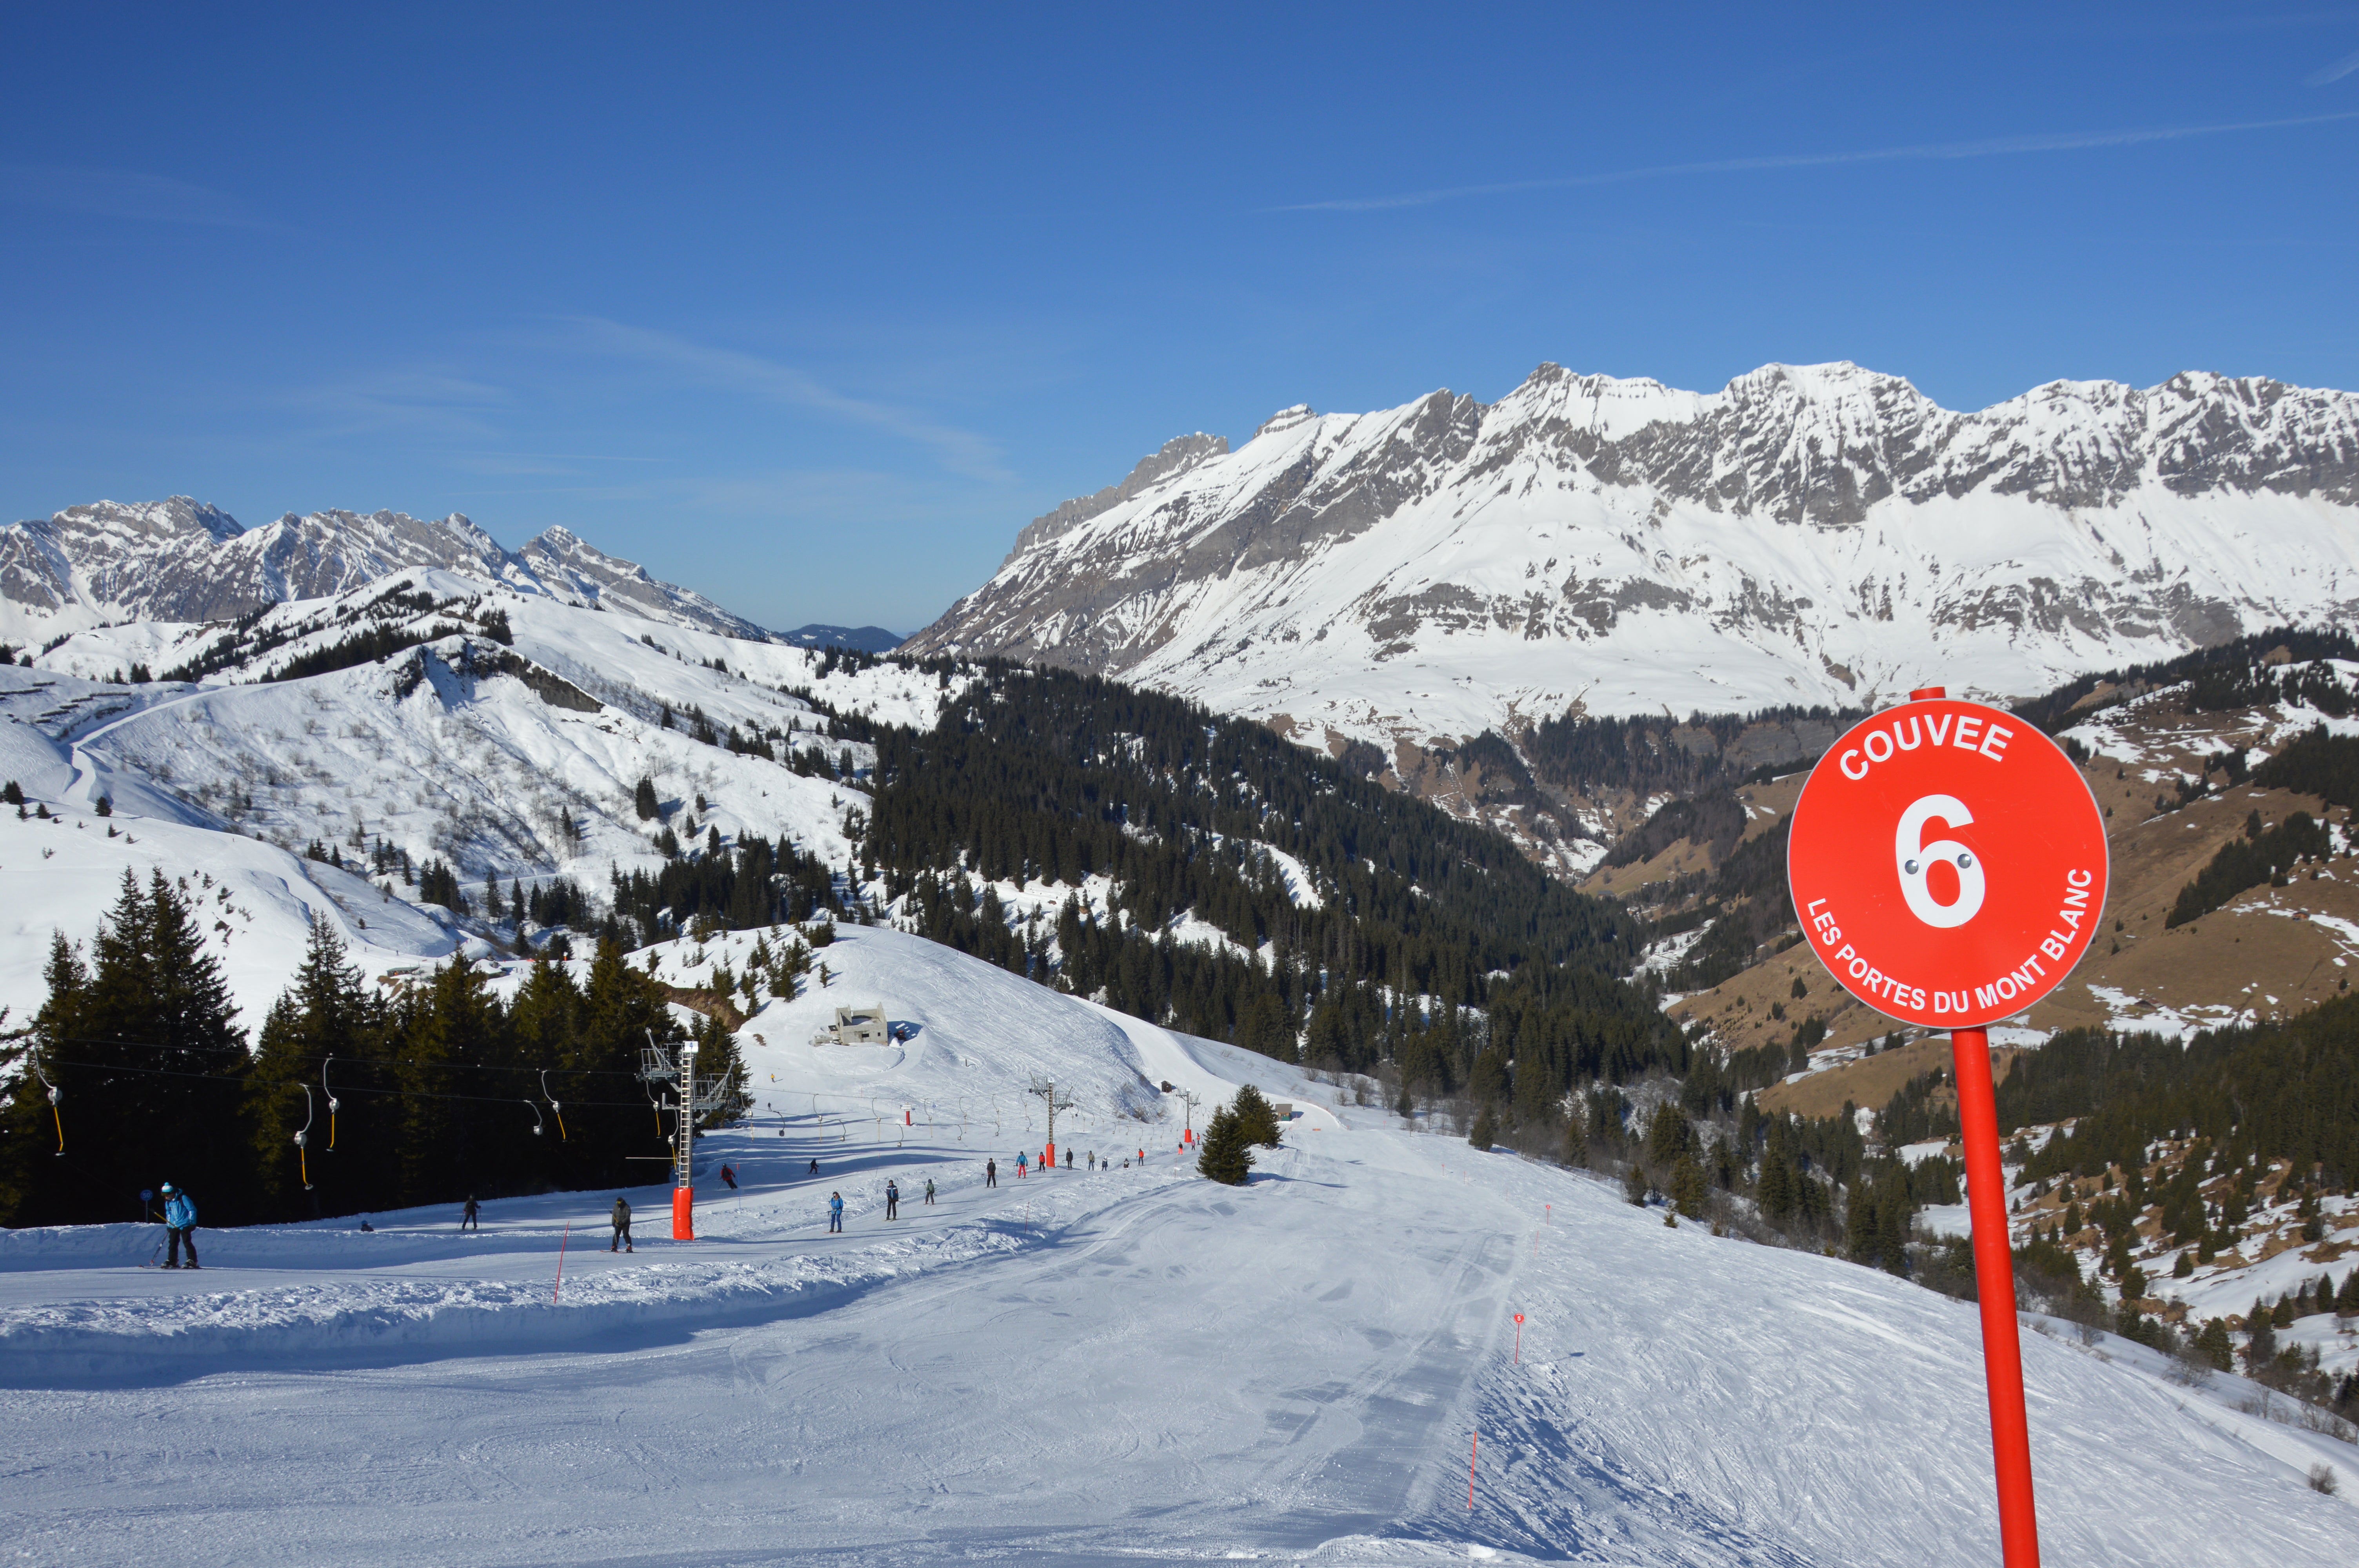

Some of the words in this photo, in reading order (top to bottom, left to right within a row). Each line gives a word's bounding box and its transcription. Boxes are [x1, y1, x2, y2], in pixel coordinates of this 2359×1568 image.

[1840, 714, 2014, 780] COUVEE
[1896, 794, 1985, 928] 6
[1808, 898, 1841, 946] LES
[1835, 944, 1926, 1010] PORTES
[1934, 990, 1968, 1013] DU
[1975, 954, 2046, 1009] MONT
[2039, 869, 2091, 961] BLANC
